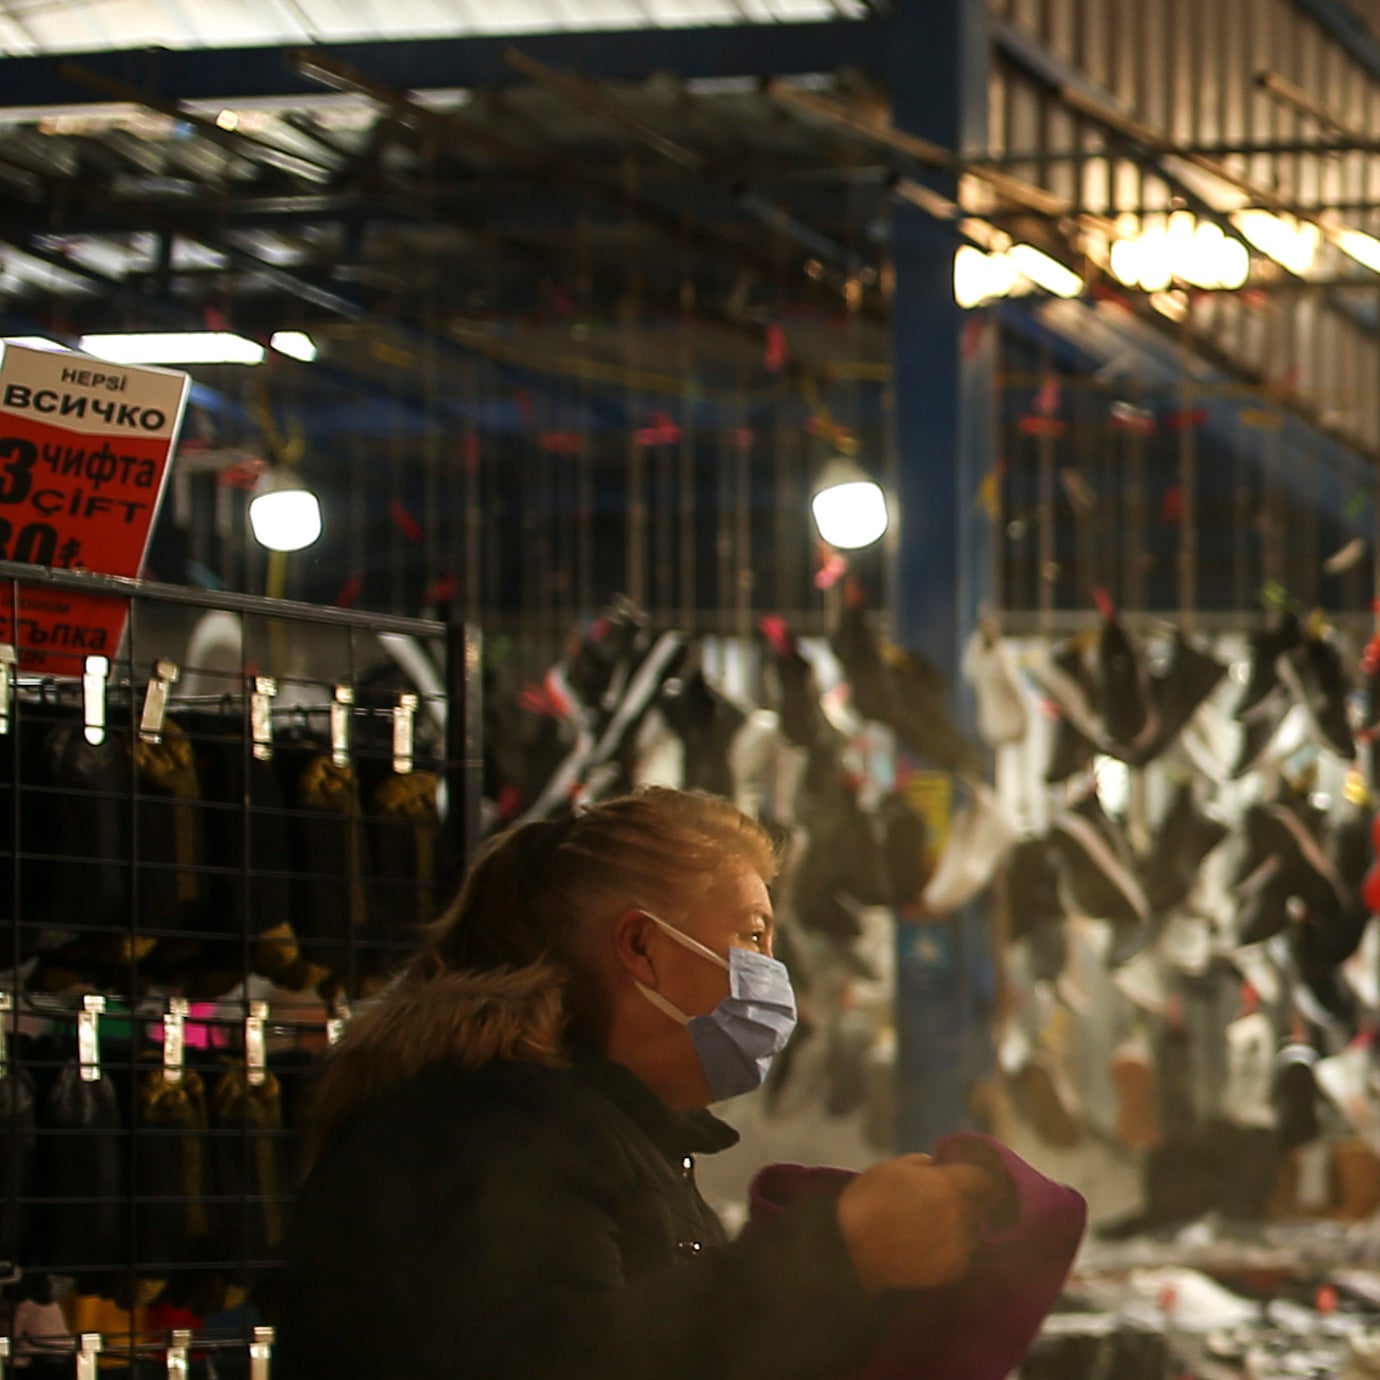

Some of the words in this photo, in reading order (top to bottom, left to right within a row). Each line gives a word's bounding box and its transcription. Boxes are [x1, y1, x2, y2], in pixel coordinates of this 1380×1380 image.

[3, 384, 166, 431] ВСИЧКО
[0, 437, 38, 504] 3
[42, 442, 156, 490] чифта
